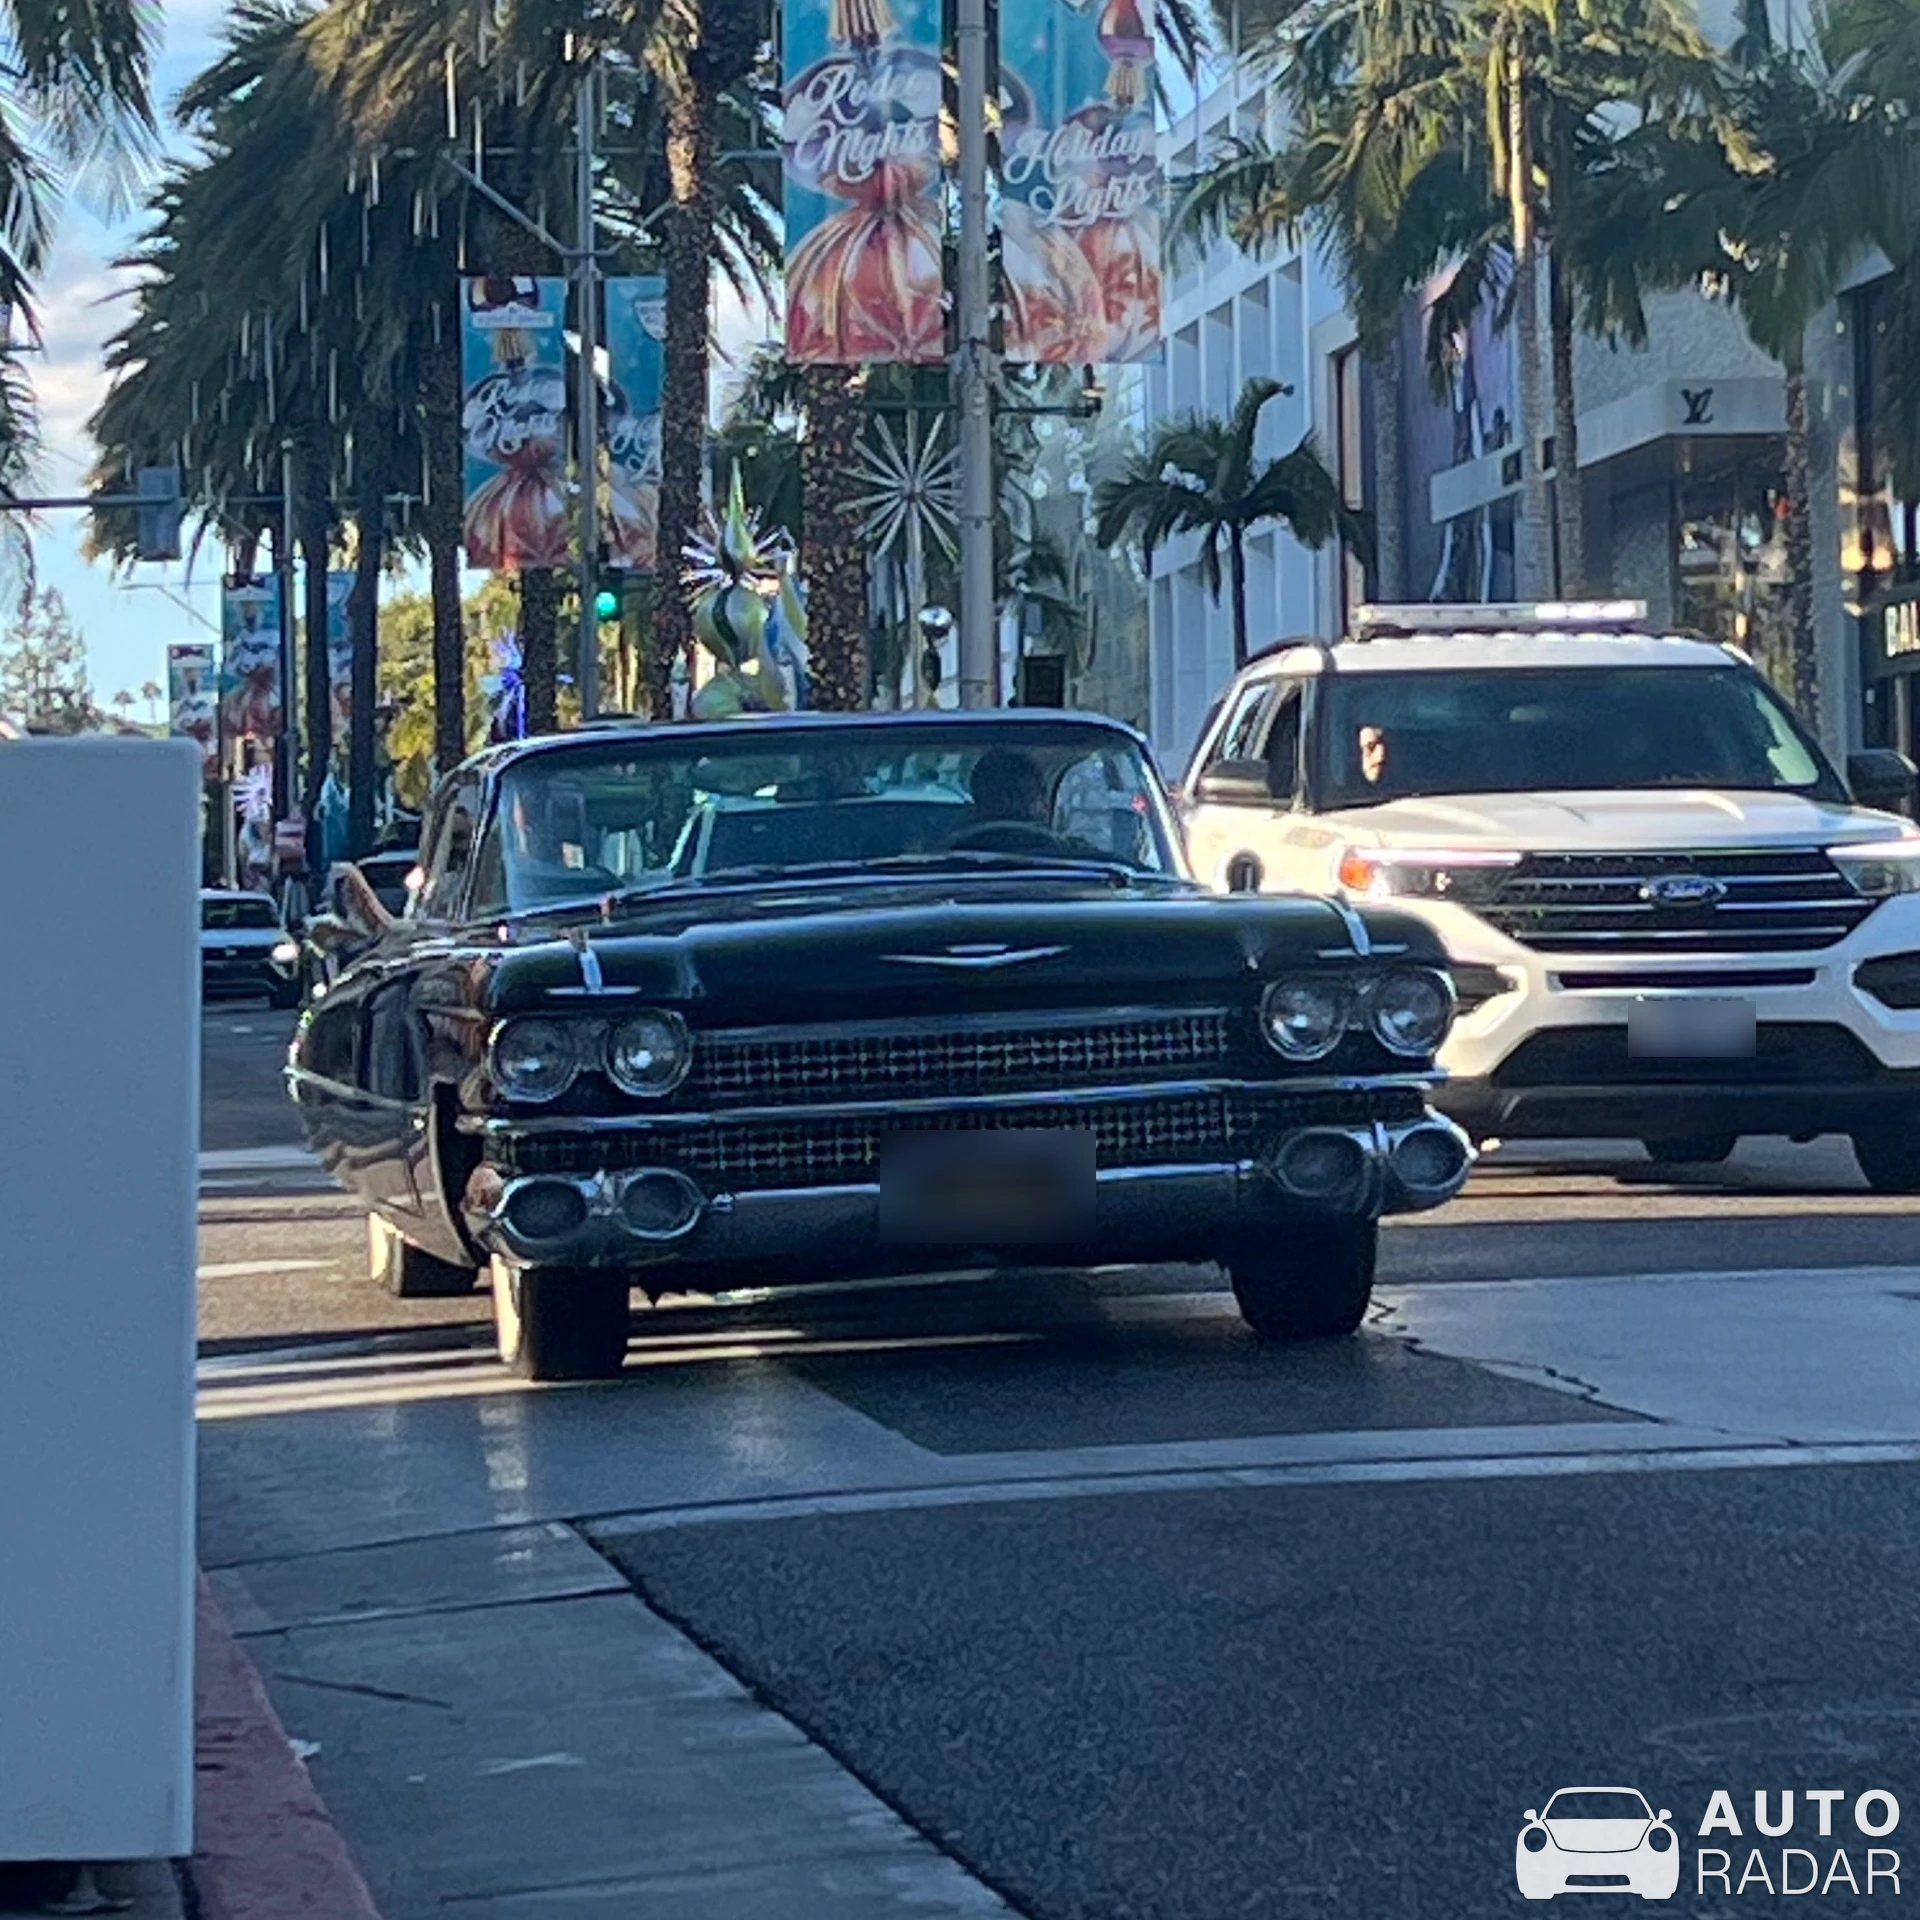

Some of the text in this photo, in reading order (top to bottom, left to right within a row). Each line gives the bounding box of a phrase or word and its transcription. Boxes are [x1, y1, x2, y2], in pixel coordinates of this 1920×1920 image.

[795, 119, 934, 183] Nights
[1003, 123, 1145, 184] Holiday
[1028, 171, 1156, 228] Lights
